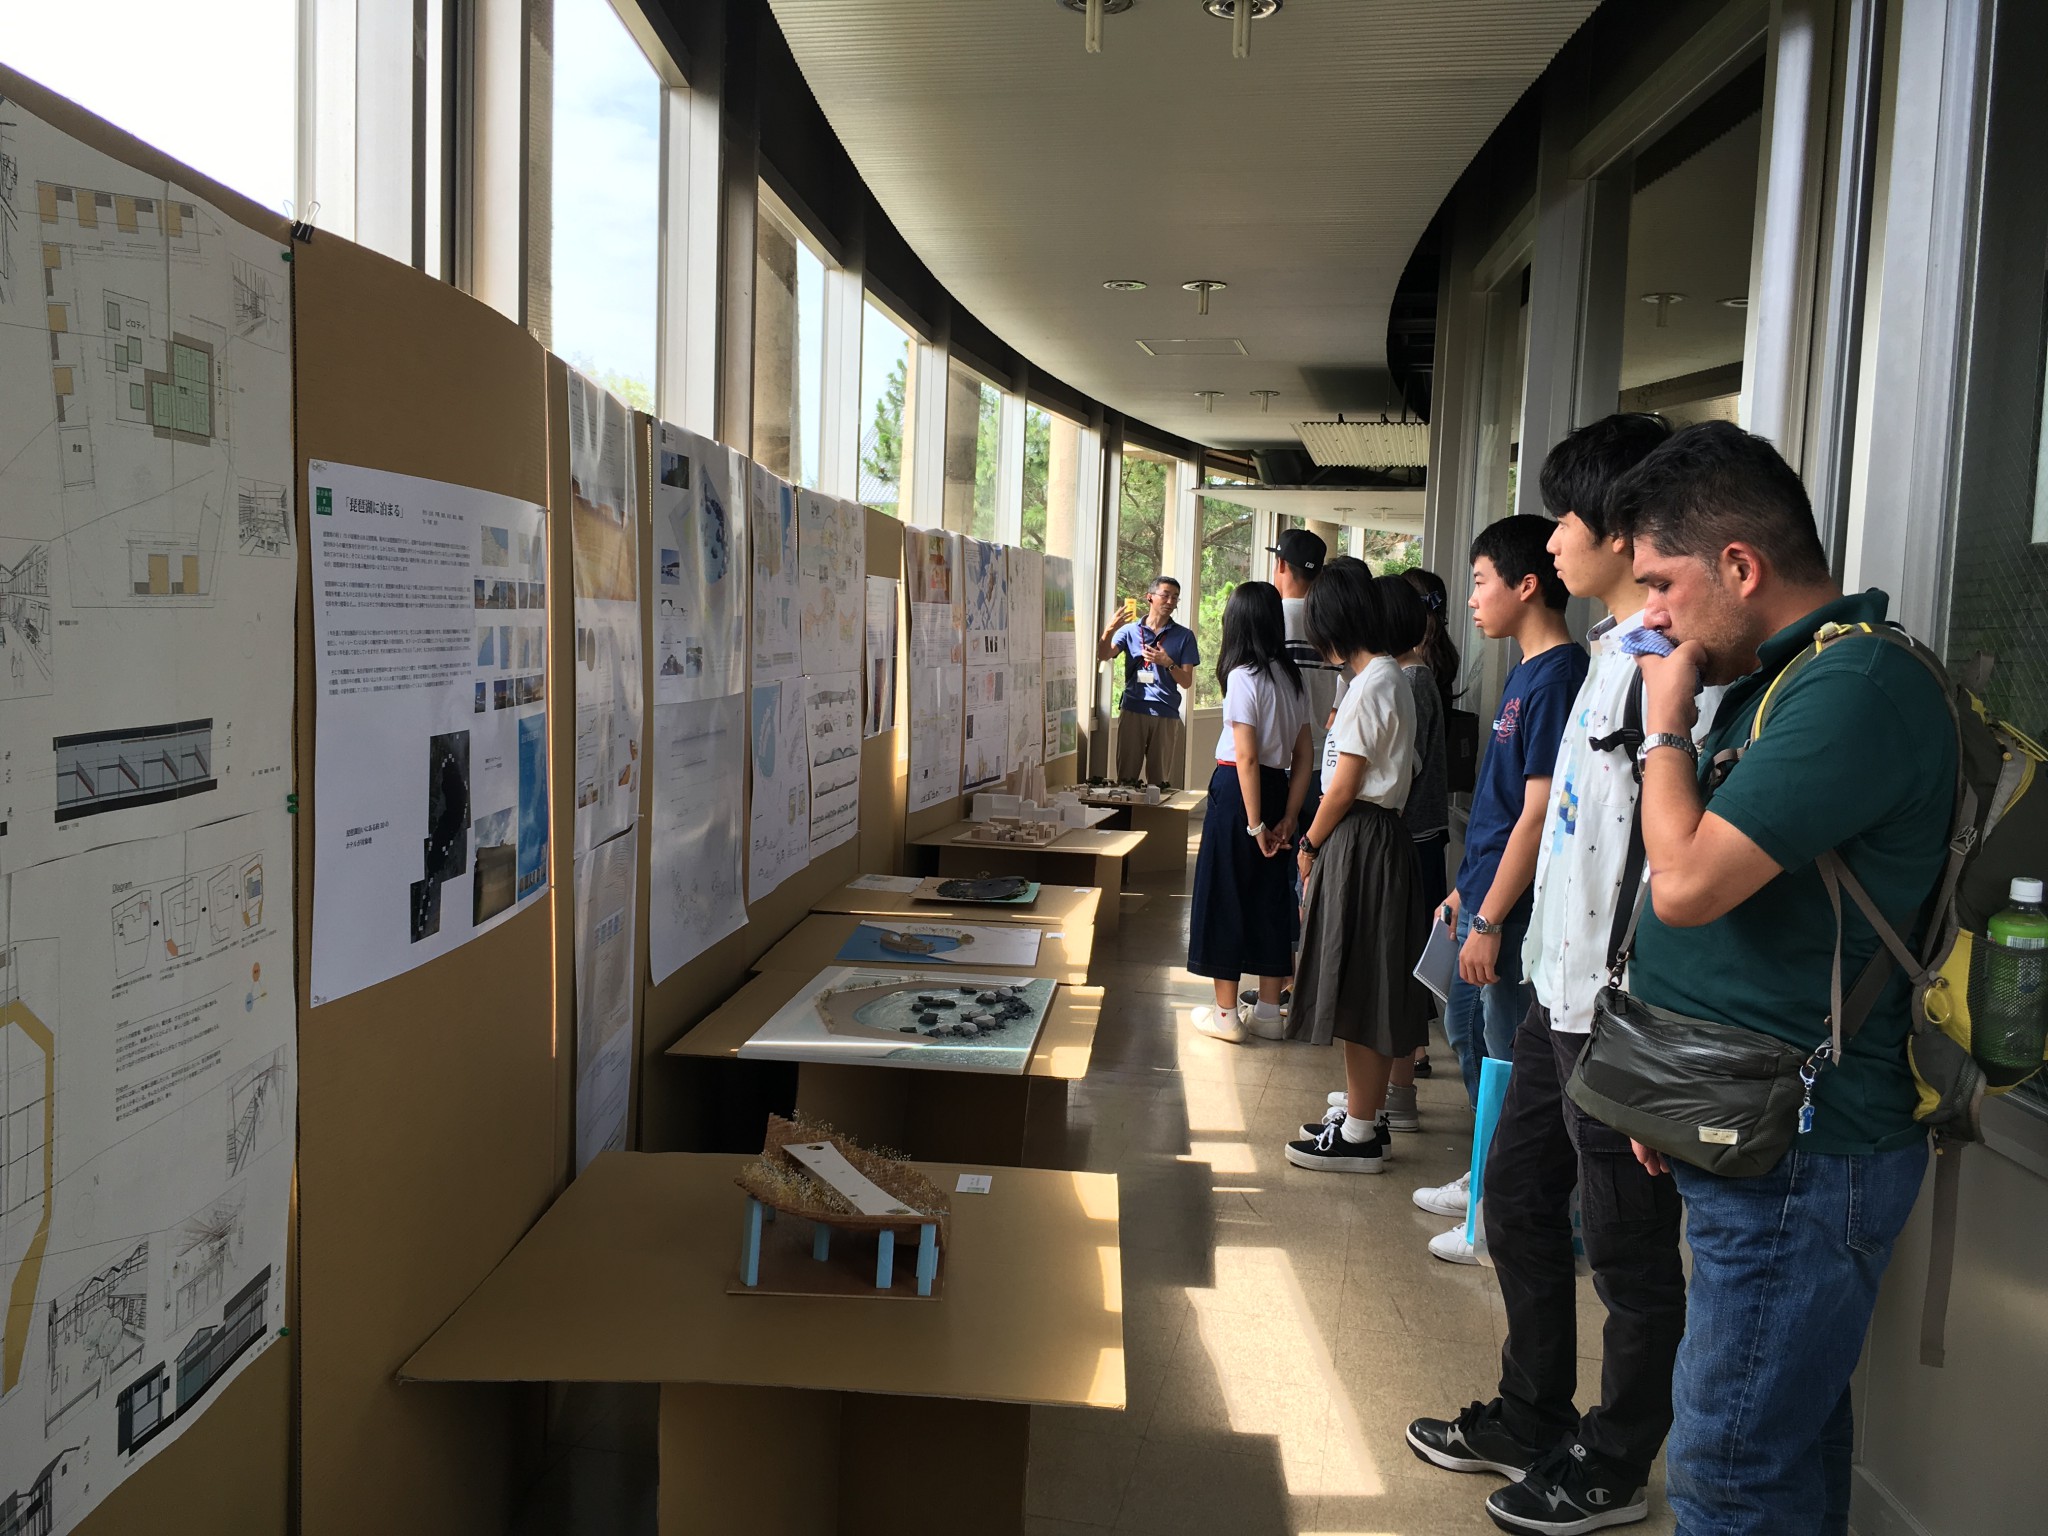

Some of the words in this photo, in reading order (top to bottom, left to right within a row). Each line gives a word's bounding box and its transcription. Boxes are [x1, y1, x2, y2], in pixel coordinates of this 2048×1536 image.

[346, 496, 404, 519] 「琵琶湖に泊まる」
[1326, 733, 1338, 768] PUS
